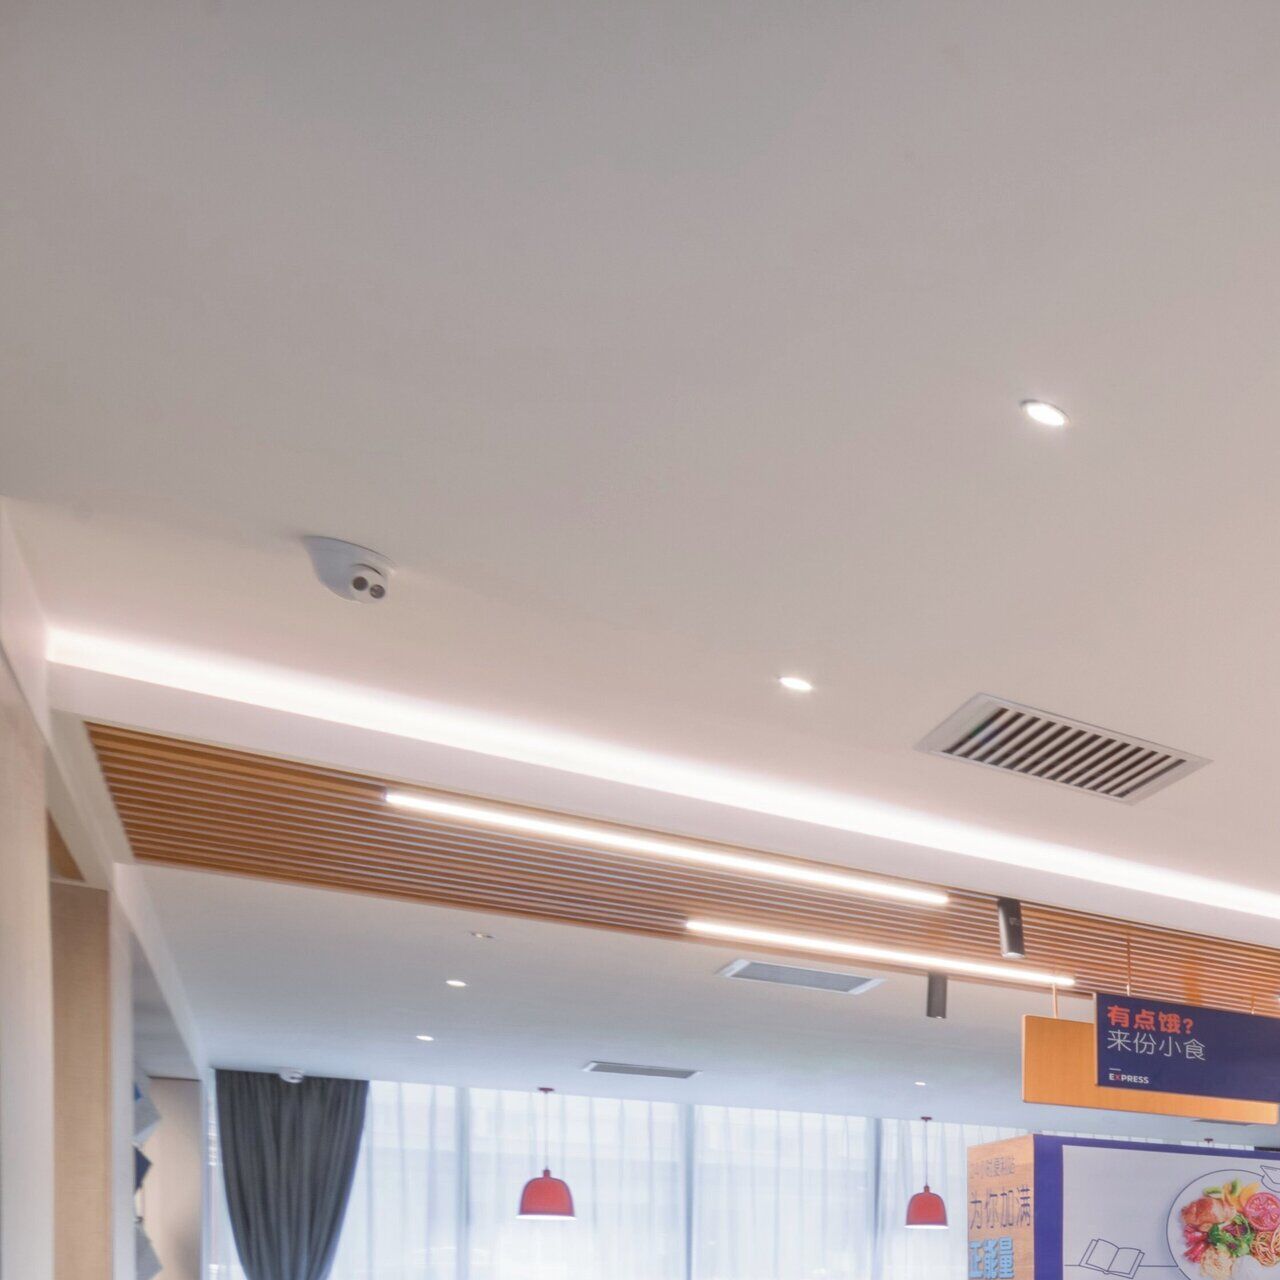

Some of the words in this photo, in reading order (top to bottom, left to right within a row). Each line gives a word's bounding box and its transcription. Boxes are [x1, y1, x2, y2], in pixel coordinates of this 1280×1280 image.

[1107, 1029, 1206, 1061] 来份小食
[1109, 1073, 1149, 1084] EXPRESS
[970, 1184, 1031, 1230] 为你加满
[969, 1236, 1015, 1279] 正能量
